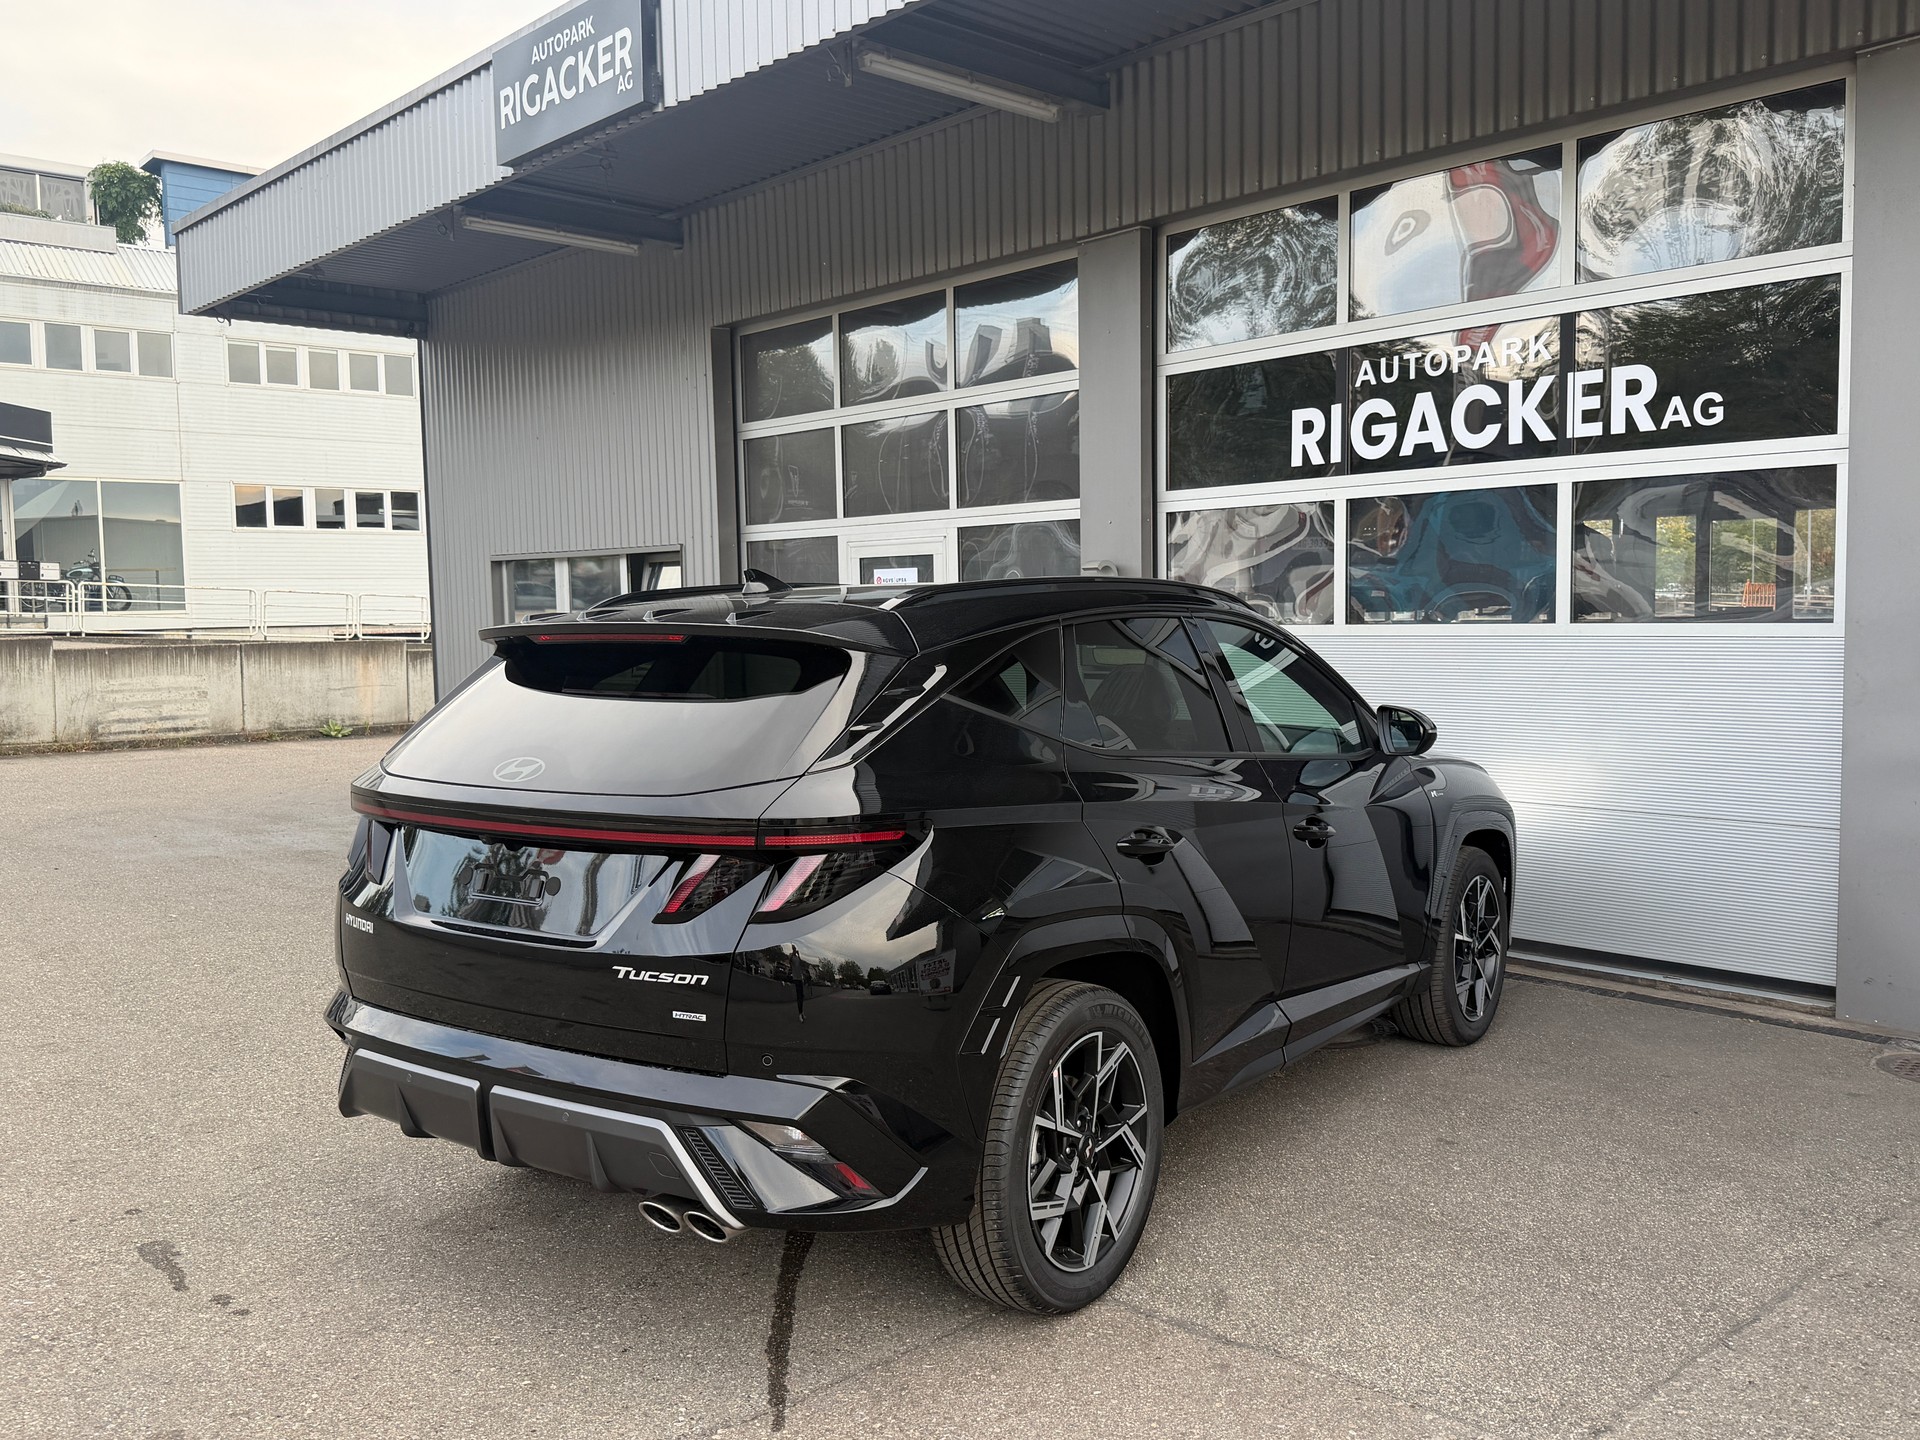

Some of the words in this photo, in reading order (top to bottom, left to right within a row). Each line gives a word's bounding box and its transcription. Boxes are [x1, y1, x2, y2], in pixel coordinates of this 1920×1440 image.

[531, 15, 595, 65] AUTOPARK
[500, 27, 633, 130] RIGACKER
[616, 70, 633, 95] AG
[1354, 331, 1553, 388] AUTOPARK
[1290, 364, 1657, 468] RIGACKER
[1660, 391, 1725, 430] AG
[345, 912, 374, 934] HYUNDAI
[674, 1012, 704, 1021] HTRAC
